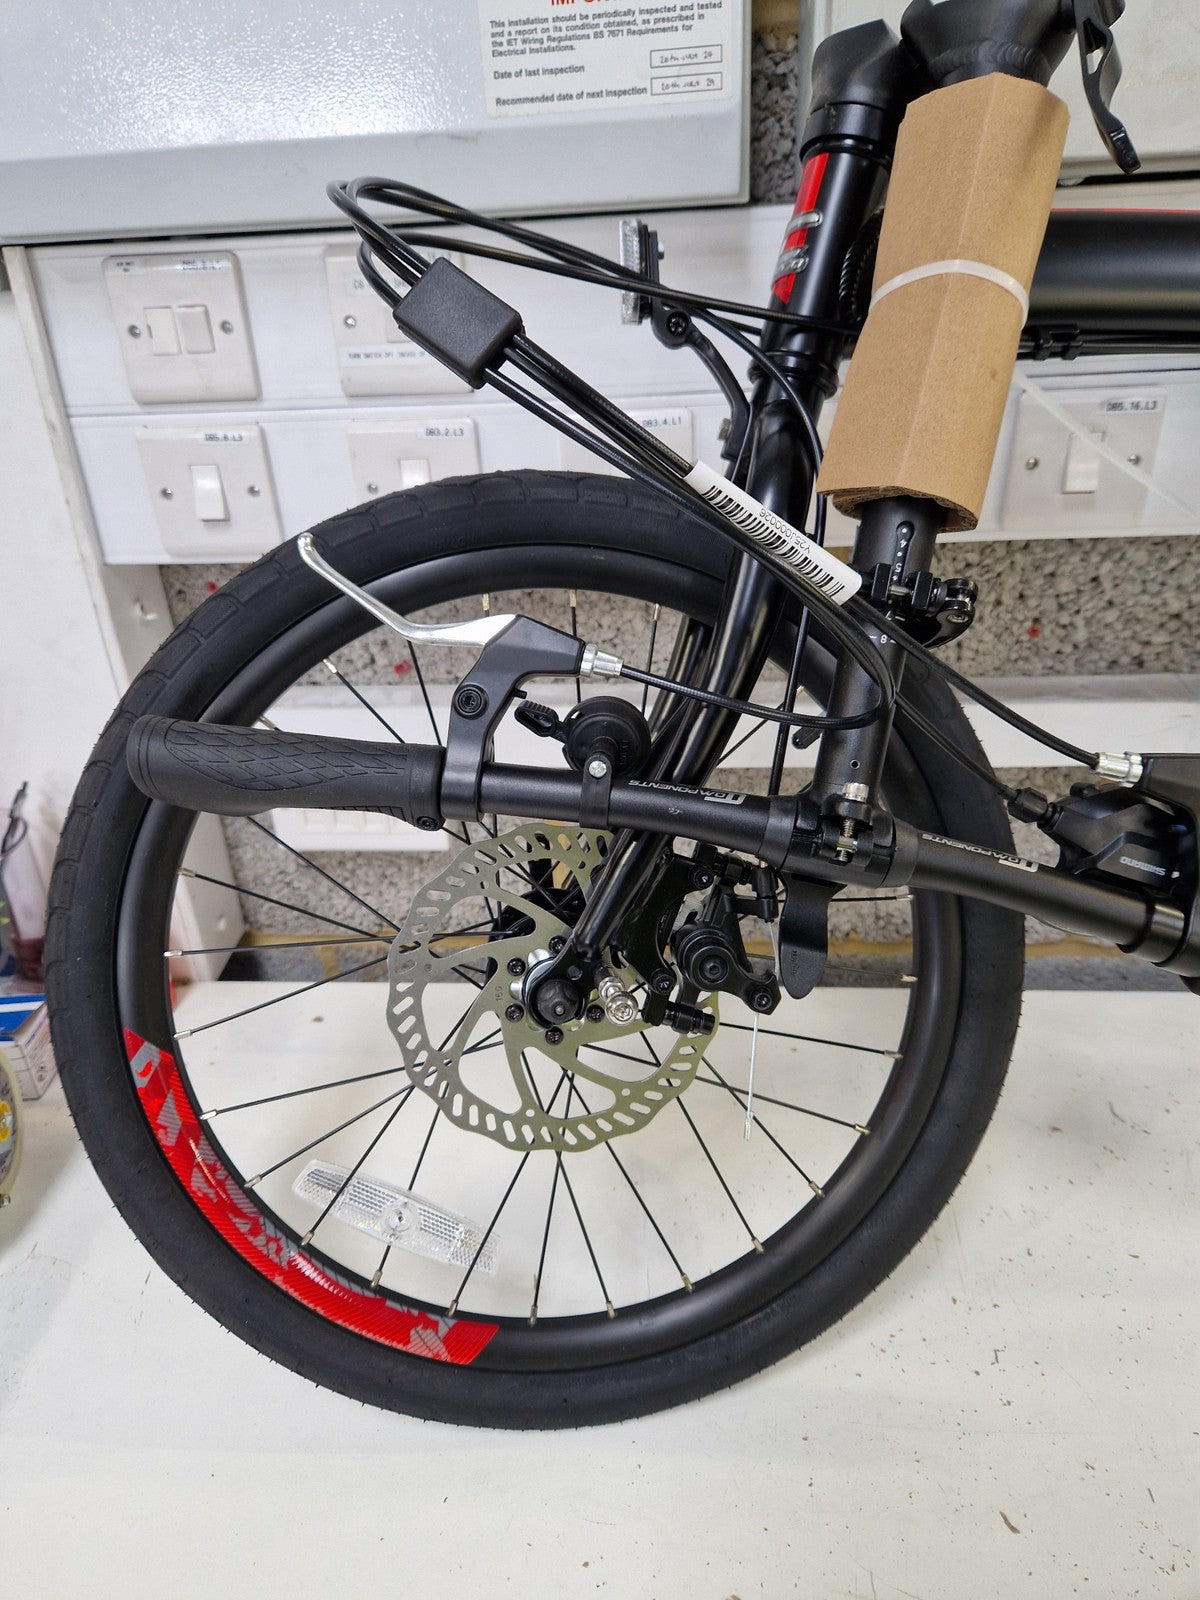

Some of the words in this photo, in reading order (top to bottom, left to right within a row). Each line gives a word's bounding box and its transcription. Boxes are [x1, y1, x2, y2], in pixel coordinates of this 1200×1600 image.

[490, 20, 505, 29] This
[552, 14, 576, 23] should
[592, 8, 636, 20] periodically
[680, 3, 694, 11] and
[697, 1, 722, 10] tested
[490, 30, 505, 38] and
[515, 27, 537, 37] report
[565, 22, 600, 32] condition
[603, 18, 638, 29] obtained,
[653, 13, 695, 25] prescribed
[491, 40, 504, 48] the
[506, 38, 518, 47] IET
[520, 36, 544, 46] Wiring
[546, 32, 591, 44] Regulations
[593, 31, 604, 39] BS
[607, 29, 624, 38] 7671
[626, 25, 679, 37] Requirements
[681, 23, 693, 31] for
[491, 47, 526, 58] Electrical
[493, 70, 512, 80] Date
[514, 68, 523, 78] of
[525, 68, 540, 77] last
[542, 65, 585, 76] inspection
[495, 93, 555, 107] Recommended
[556, 92, 573, 101] date
[575, 91, 584, 100] of
[586, 89, 604, 99] next
[605, 86, 647, 98] inspection
[760, 508, 811, 554] Y25J000026
[880, 634, 888, 644] 8
[1119, 856, 1167, 876] SHIMANO
